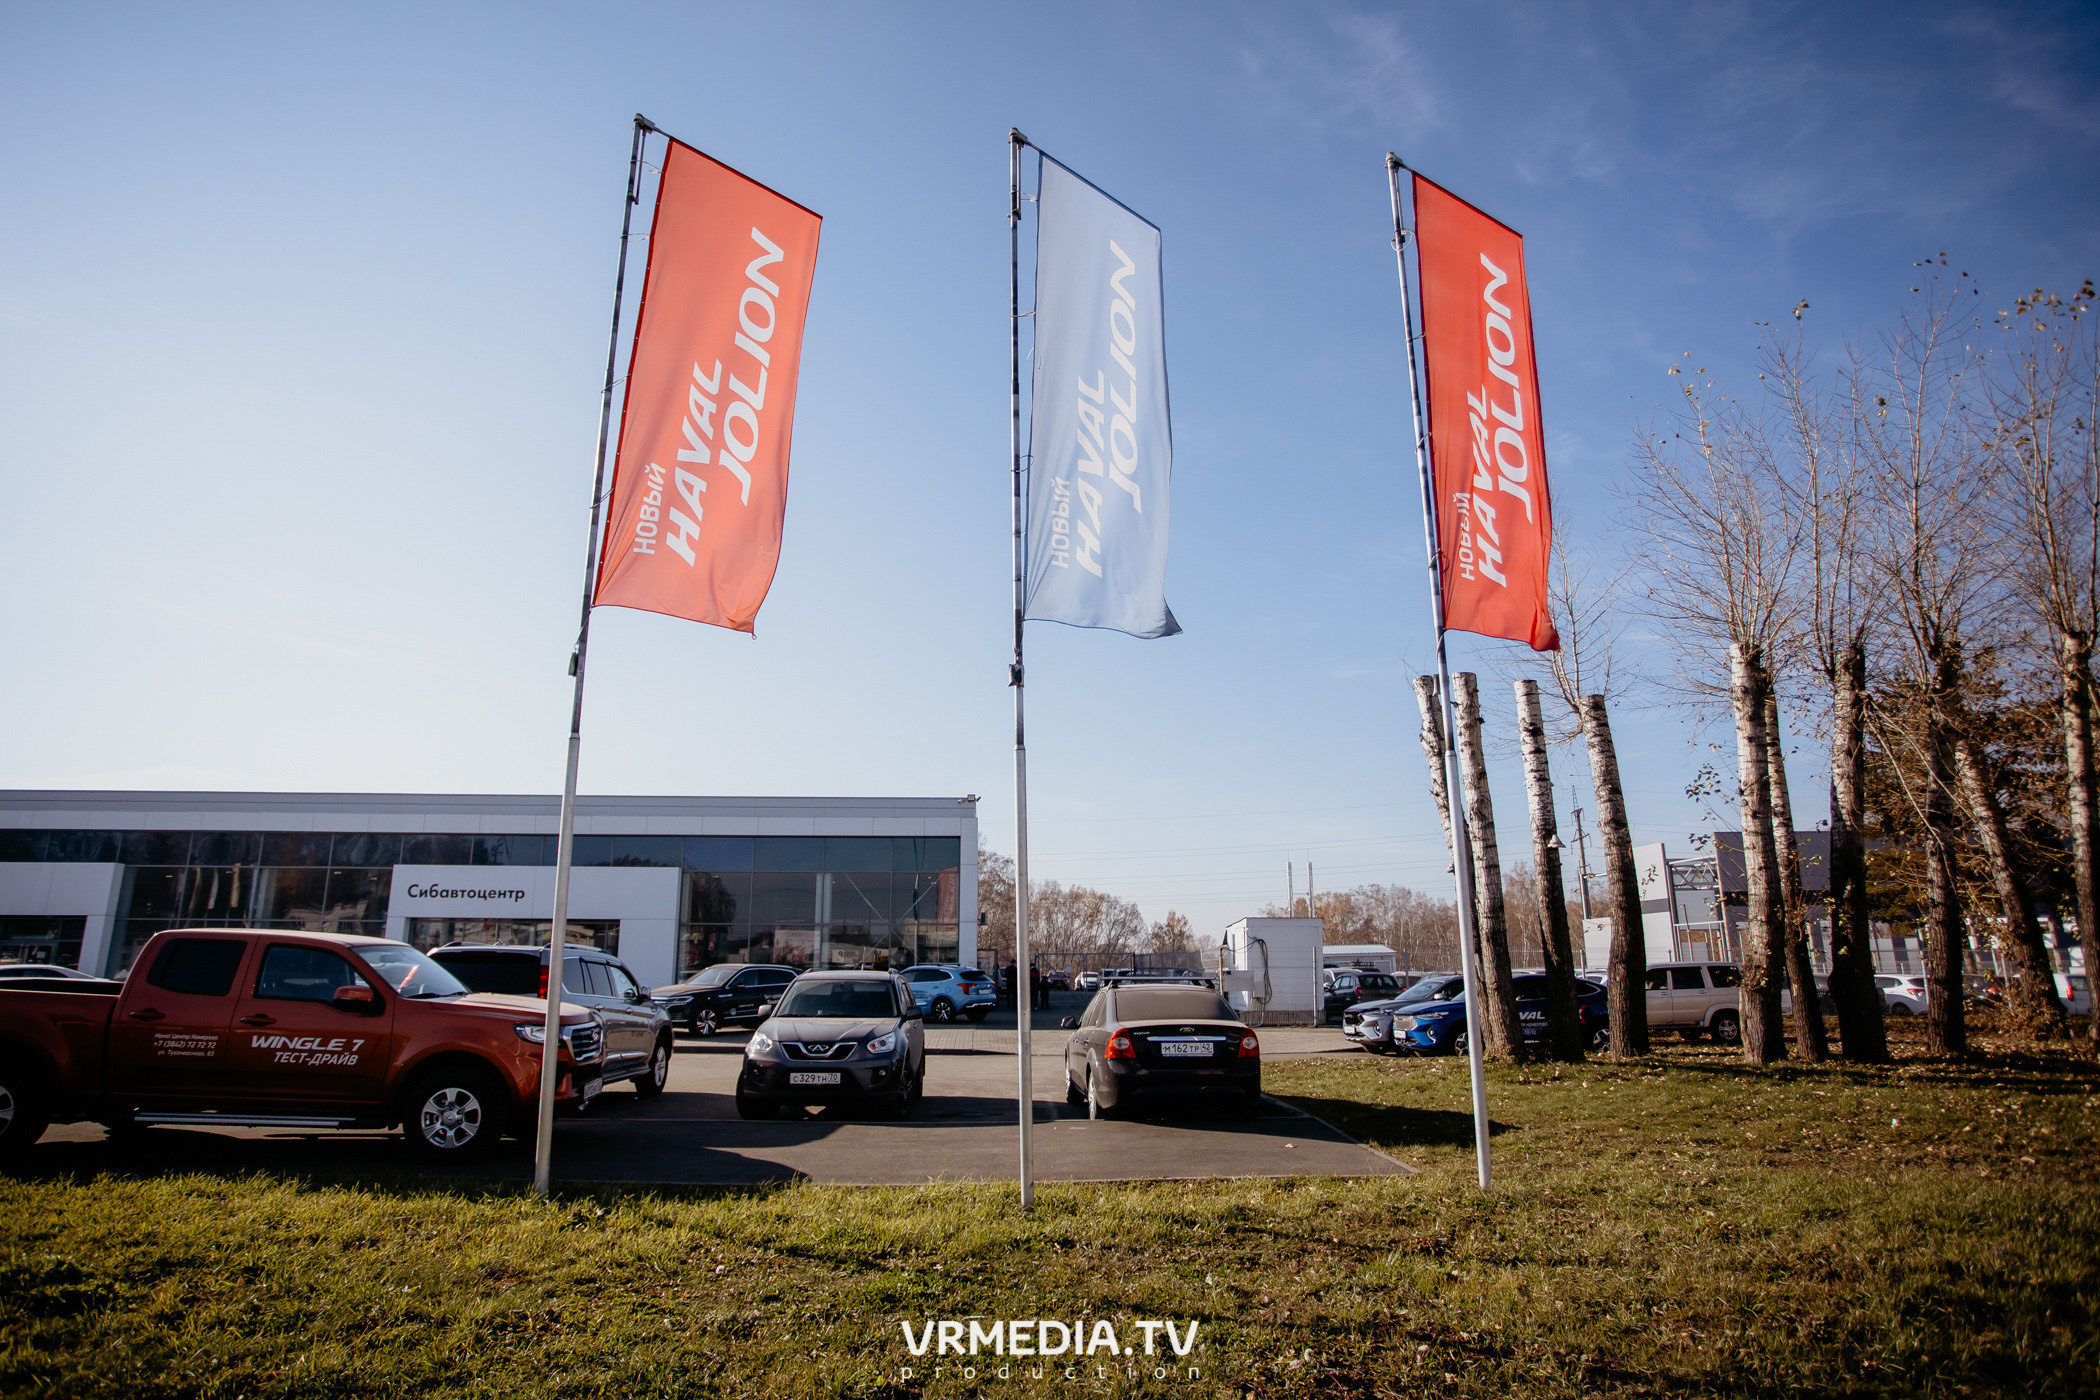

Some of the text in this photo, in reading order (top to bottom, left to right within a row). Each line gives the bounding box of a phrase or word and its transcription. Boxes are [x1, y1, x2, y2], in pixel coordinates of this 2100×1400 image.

[718, 226, 785, 507] JOLION
[1108, 239, 1142, 514] JOLION
[1480, 252, 1533, 525] JOLION
[665, 358, 722, 567] HAVAL
[1074, 369, 1105, 578] HAVAL
[1467, 384, 1508, 588] HAVAL
[633, 463, 666, 555] НОВЫЙ
[1050, 478, 1071, 569] НОВЫЙ
[1453, 492, 1475, 581] НОВЫЙ
[407, 883, 526, 903] Сибавтоцентр
[163, 1040, 187, 1048] (3842)
[197, 1041, 207, 1049] 72
[207, 1041, 217, 1049] 72
[251, 1035, 365, 1051] WINGLE 7
[273, 1052, 359, 1066] ТЕСТ-ДРАЙВ
[1519, 1011, 1546, 1020] VAL
